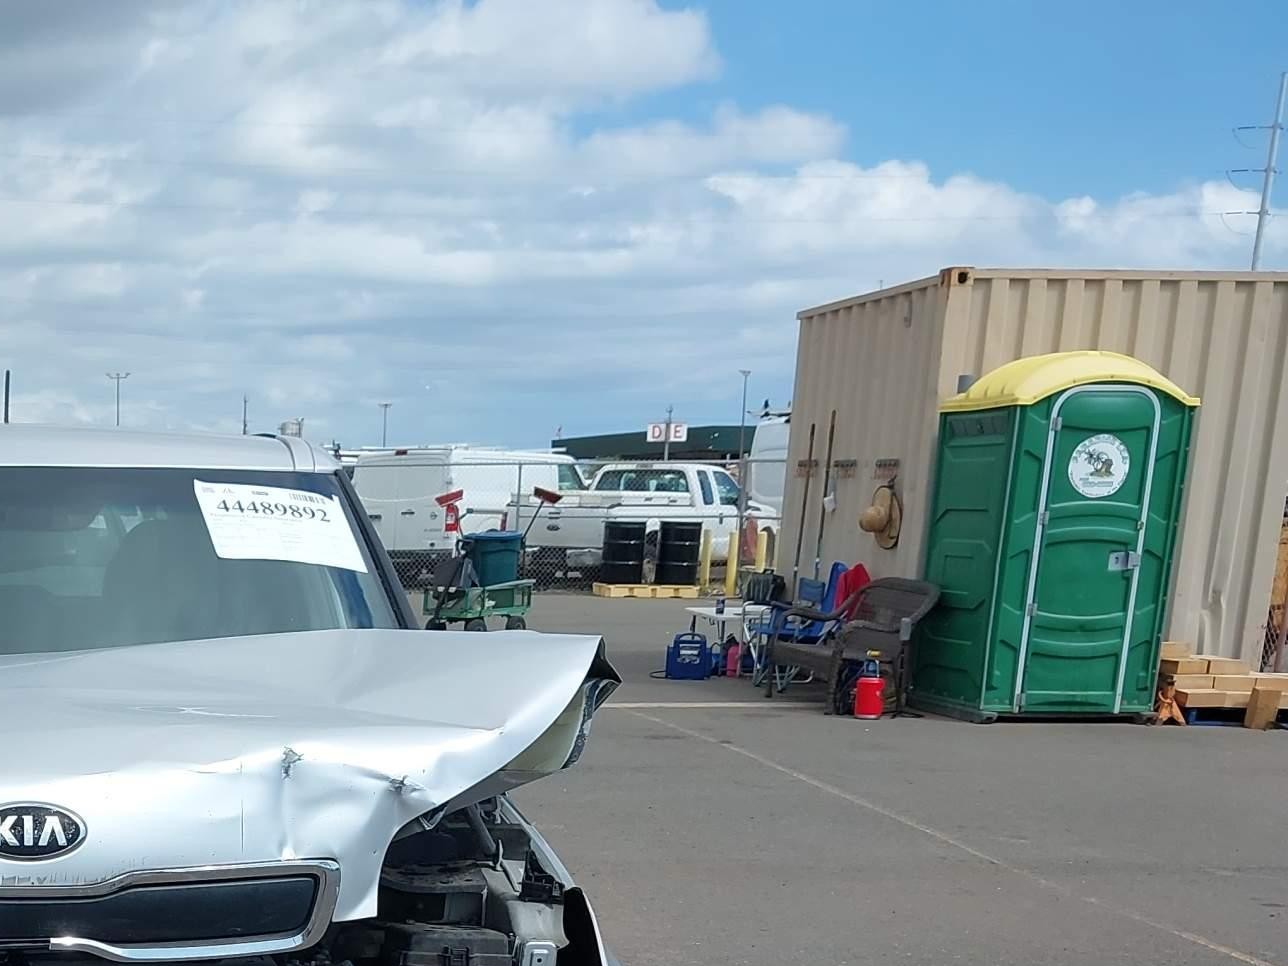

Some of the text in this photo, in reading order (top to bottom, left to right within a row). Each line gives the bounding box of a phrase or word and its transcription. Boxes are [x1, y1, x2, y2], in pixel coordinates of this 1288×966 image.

[652, 425, 662, 439] D
[674, 425, 683, 439] E
[216, 499, 331, 523] 44489892
